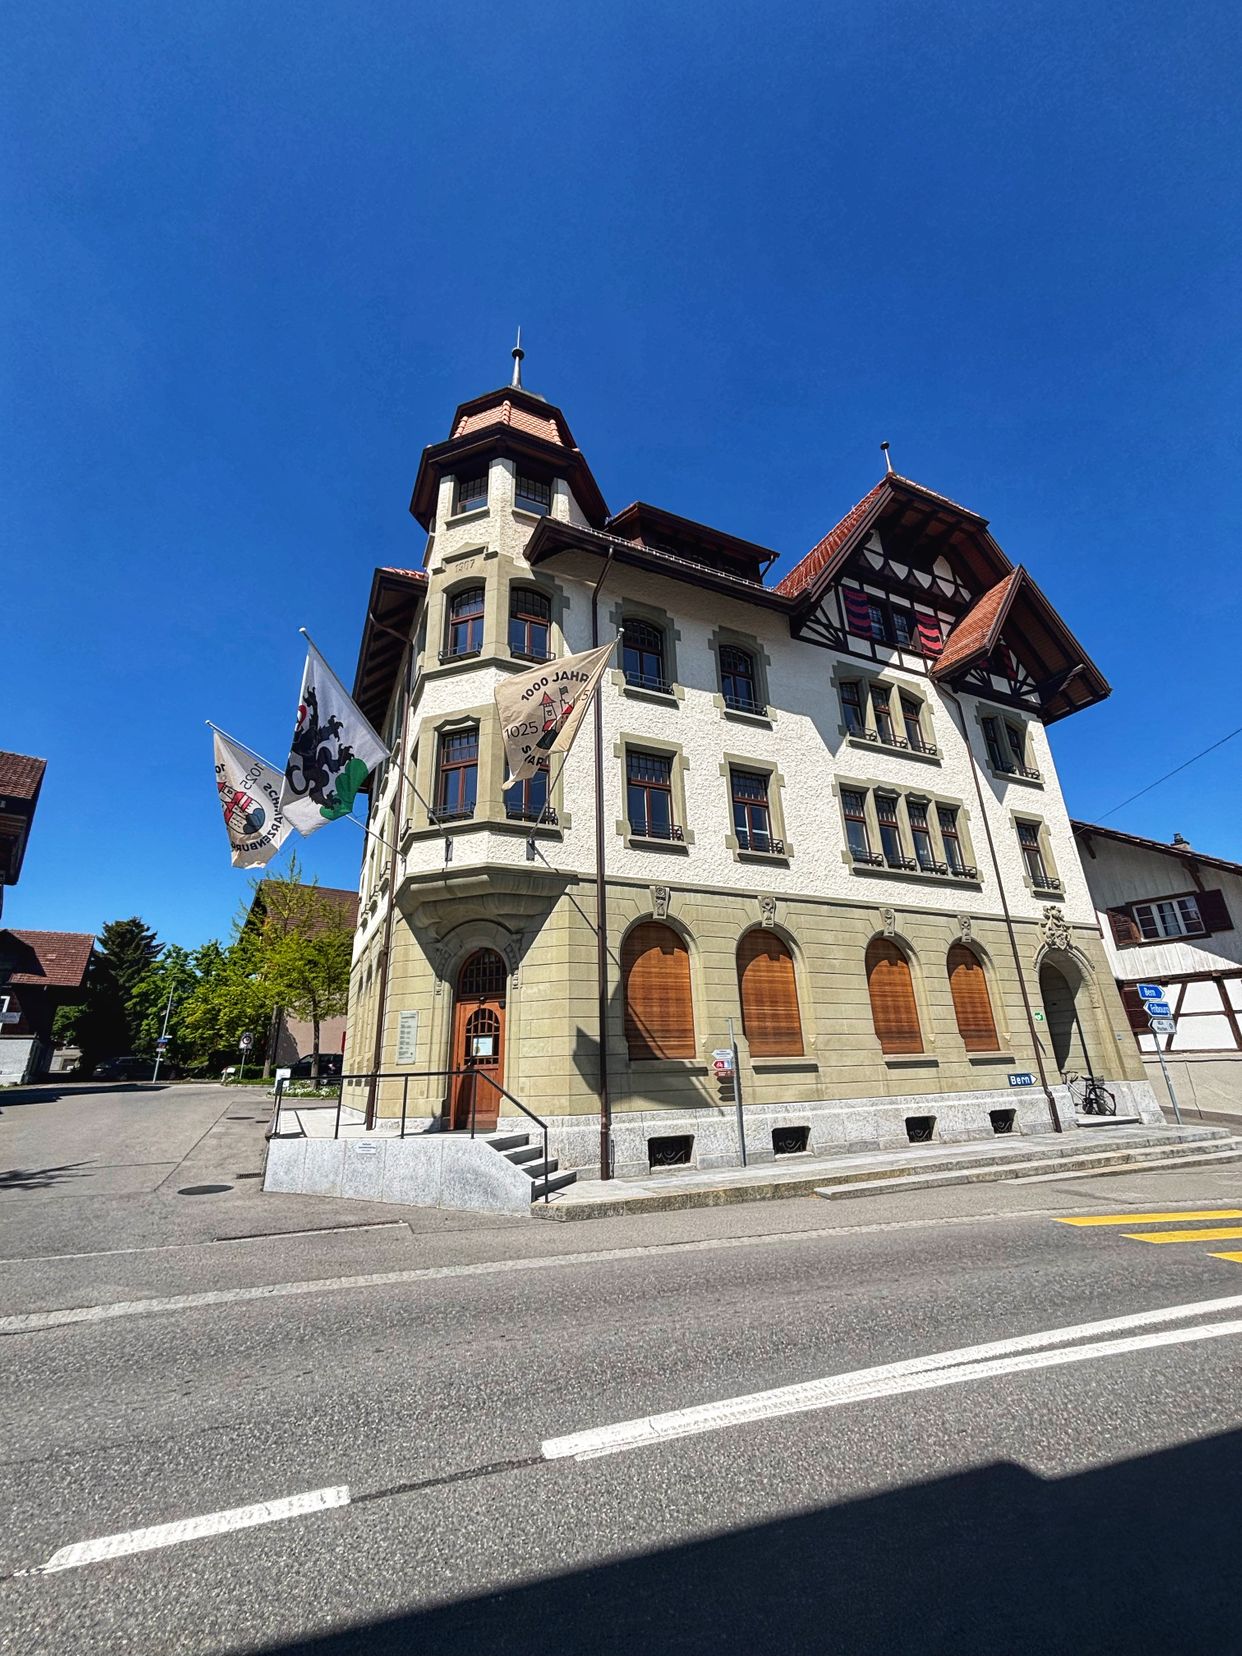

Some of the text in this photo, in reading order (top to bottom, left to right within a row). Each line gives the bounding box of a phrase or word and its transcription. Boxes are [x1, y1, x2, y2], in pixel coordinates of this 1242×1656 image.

[521, 670, 589, 702] 1000 JAHR
[504, 721, 539, 739] 1025
[1009, 1075, 1031, 1086] Bern
